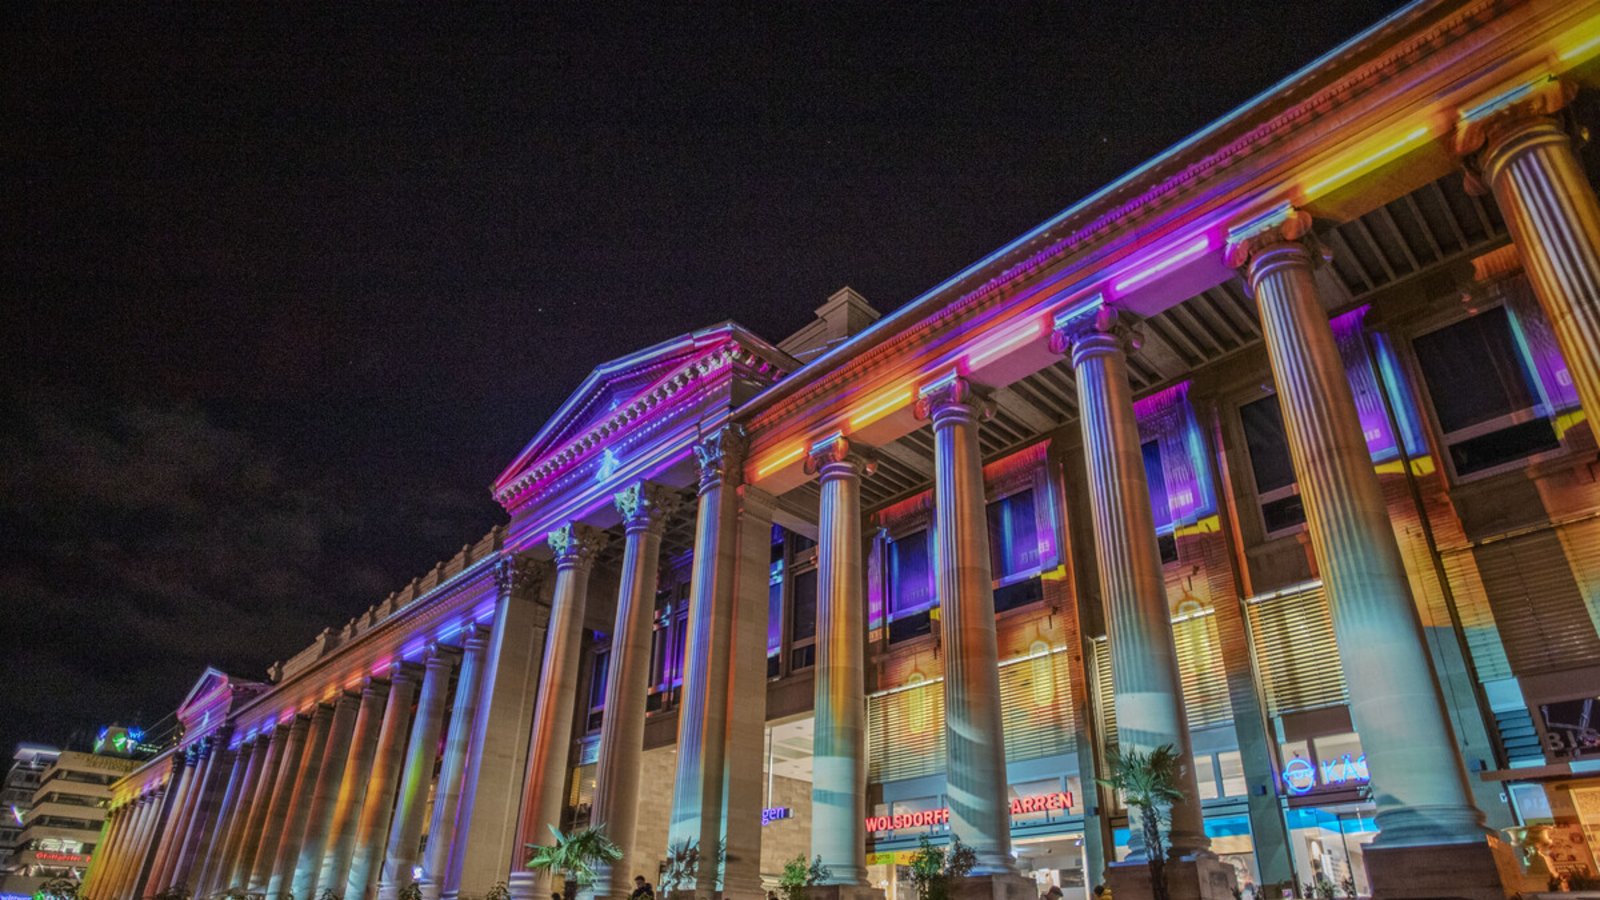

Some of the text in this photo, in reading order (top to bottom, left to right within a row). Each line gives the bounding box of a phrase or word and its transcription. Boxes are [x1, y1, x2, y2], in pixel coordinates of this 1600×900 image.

[761, 805, 784, 827] gen
[865, 791, 1074, 833] WOLSDORFF ARREN
